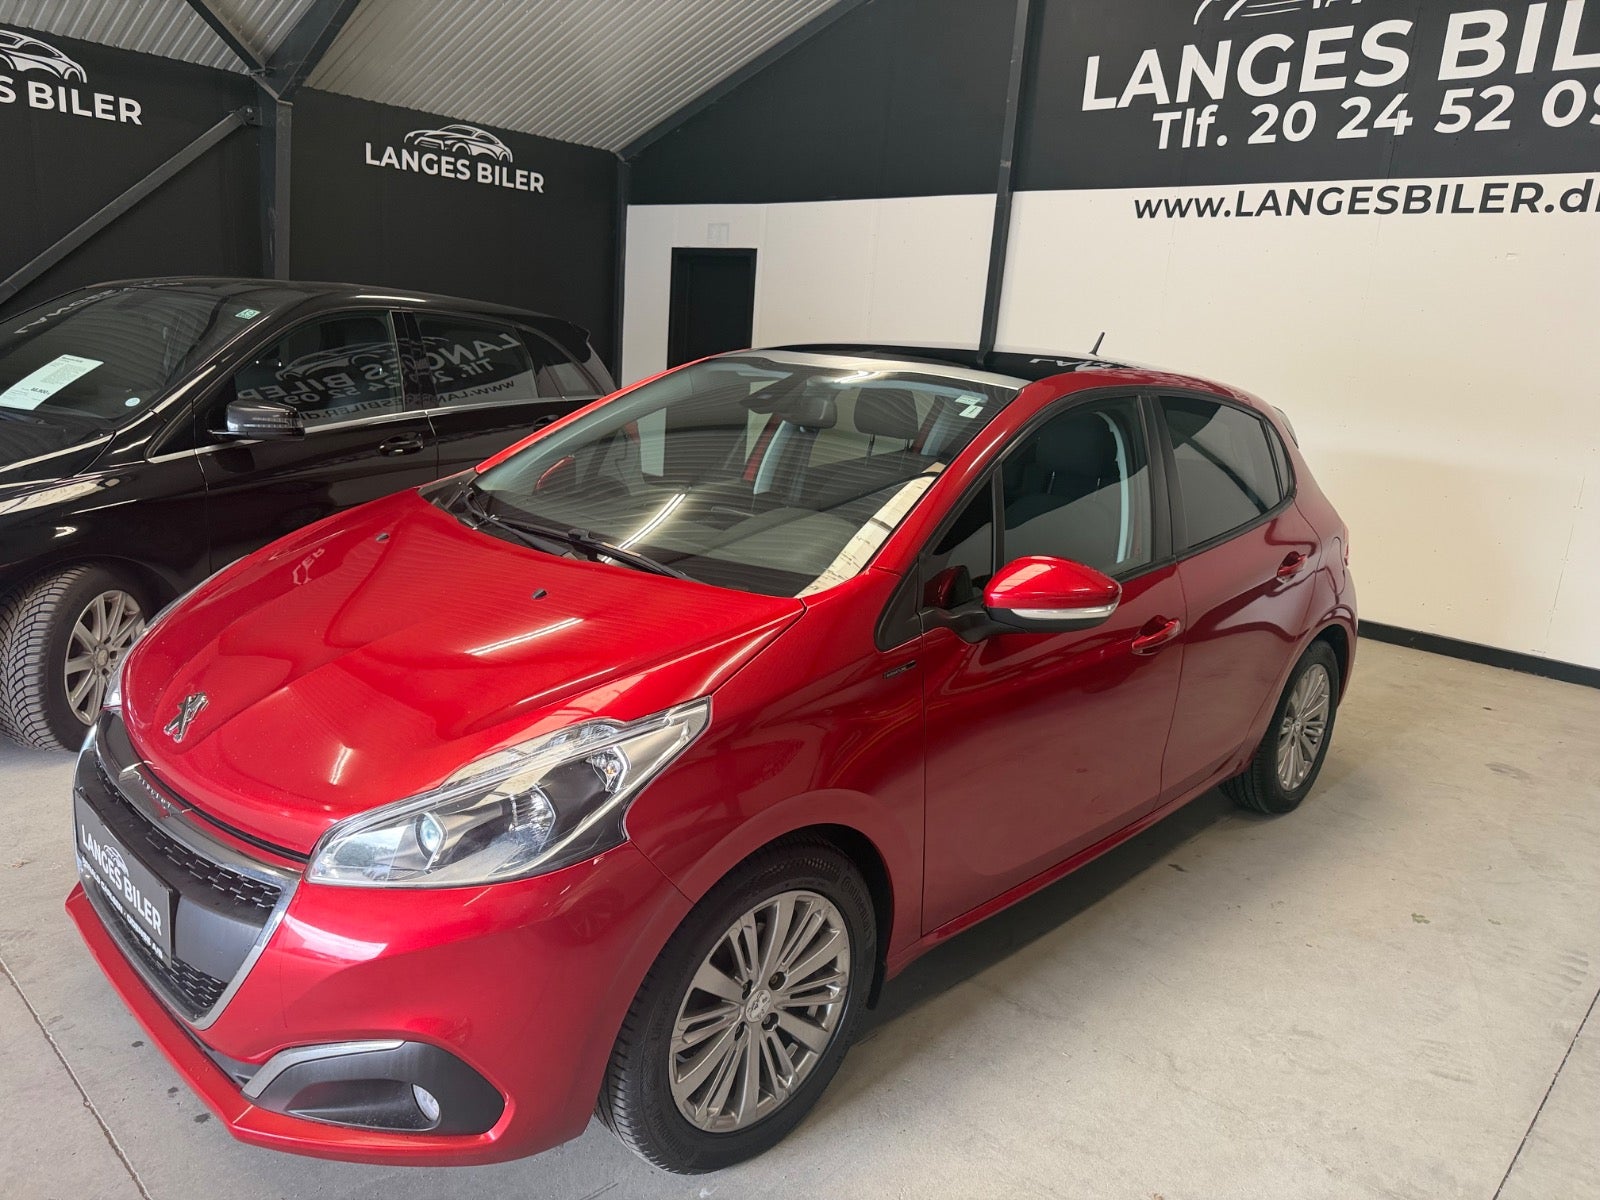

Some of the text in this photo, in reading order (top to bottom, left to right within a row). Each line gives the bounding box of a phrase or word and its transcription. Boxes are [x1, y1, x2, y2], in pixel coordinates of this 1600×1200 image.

[1082, 19, 1414, 111] LANGES
[27, 80, 143, 126] BILER
[1152, 79, 1600, 150] Tlf. 20 24 52 0
[365, 142, 545, 194] LANGES BILER
[1134, 179, 1600, 219] www.LANGESBILER.d
[81, 824, 123, 891] LANGES
[123, 877, 162, 936] BILER
